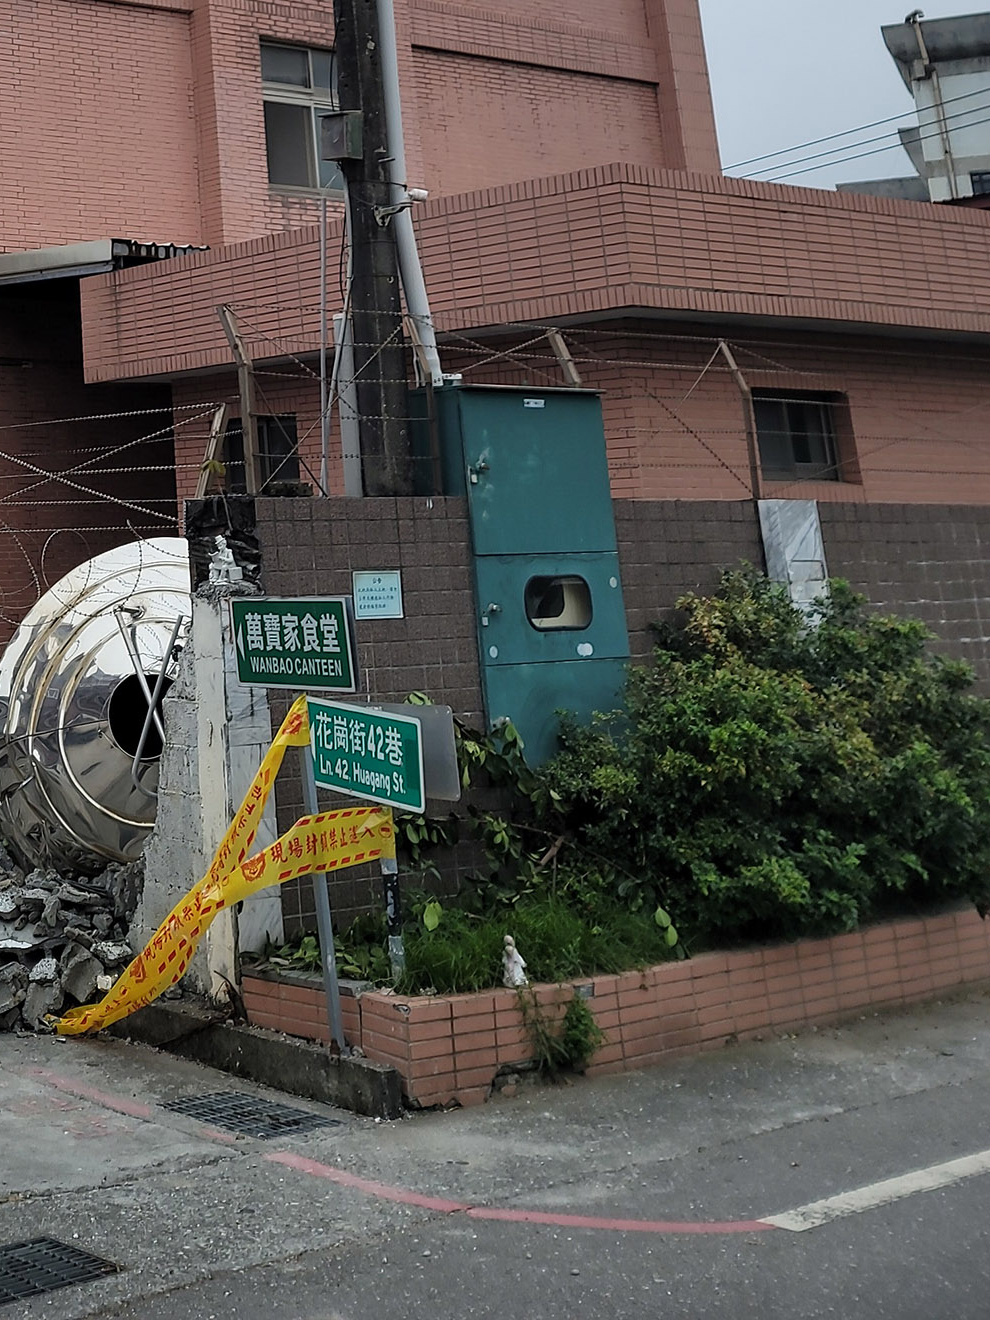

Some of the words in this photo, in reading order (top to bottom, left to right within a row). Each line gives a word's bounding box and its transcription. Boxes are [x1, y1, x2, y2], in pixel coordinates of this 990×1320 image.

[244, 612, 341, 653] 萬寶家食堂
[250, 656, 293, 674] WANBAO
[294, 658, 343, 676] CANTEEN
[315, 711, 404, 766] 花崗街42巷
[319, 754, 334, 776] Ln.
[353, 761, 391, 797] Huagang
[392, 771, 406, 795] St.
